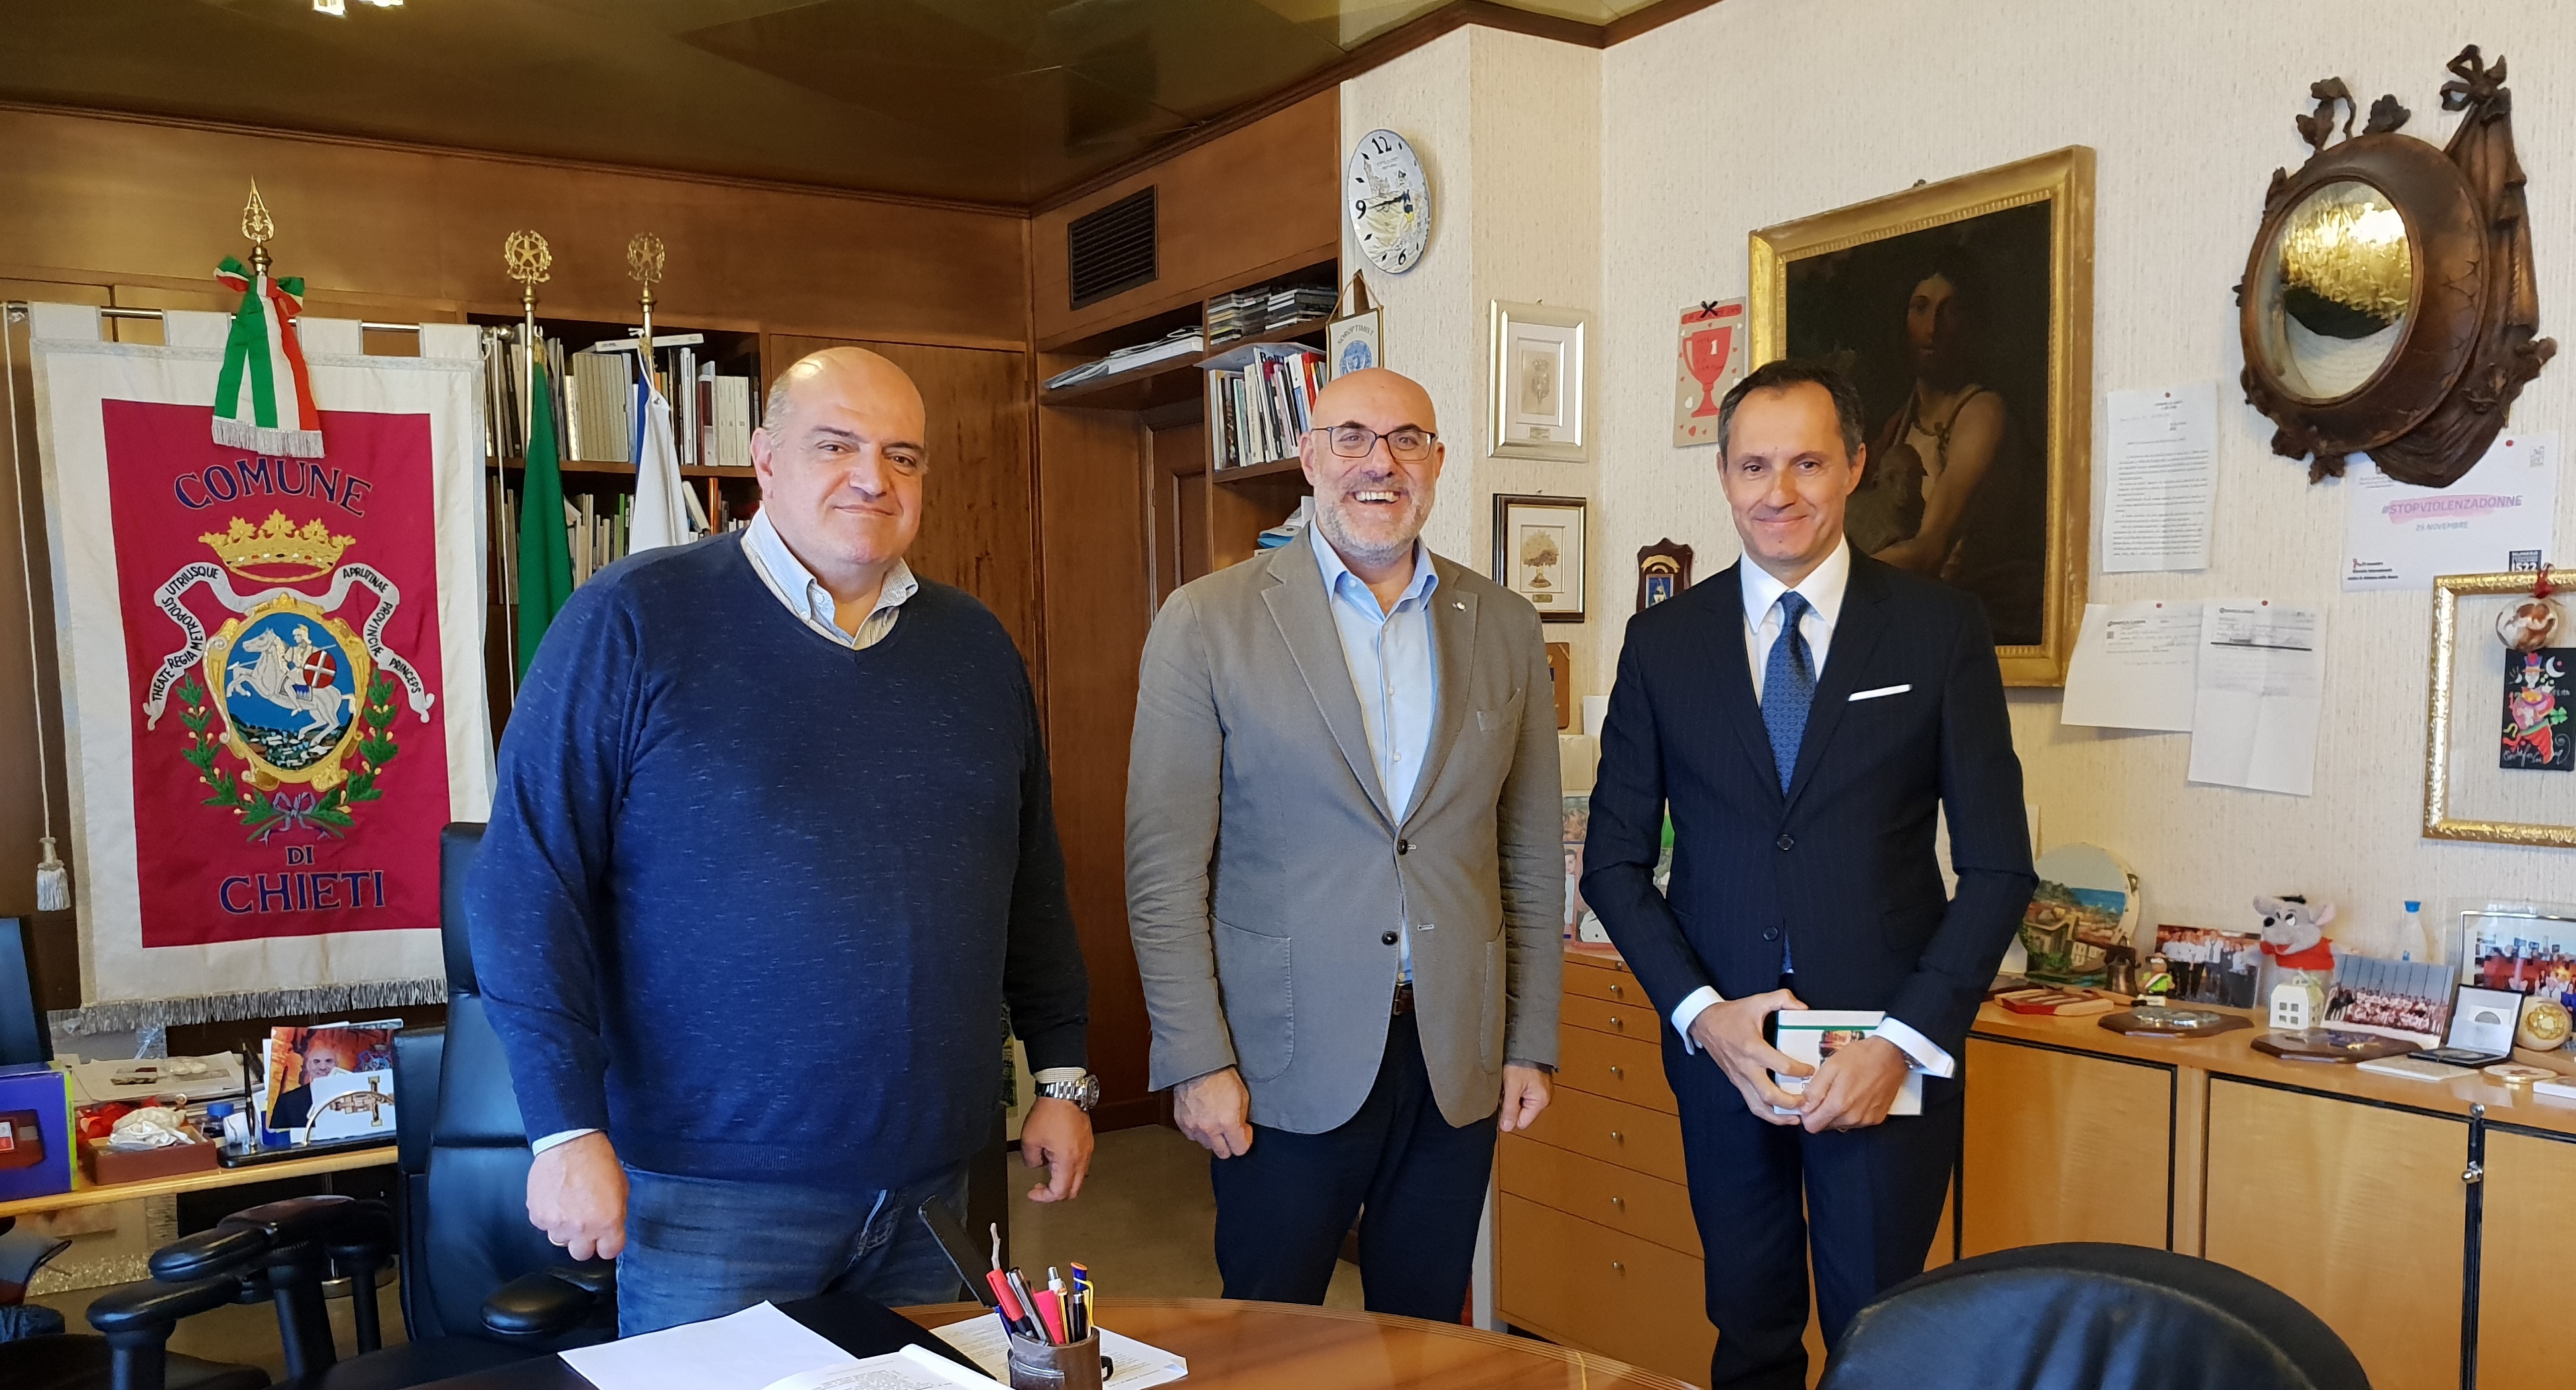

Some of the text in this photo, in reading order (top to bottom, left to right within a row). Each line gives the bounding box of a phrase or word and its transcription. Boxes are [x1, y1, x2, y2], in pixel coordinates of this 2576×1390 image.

[1371, 136, 1392, 154] 12
[1355, 200, 1367, 219] 9
[1398, 249, 1406, 265] 6
[1337, 324, 1375, 345] SOROPTIMIST
[174, 457, 373, 518] COMUNE
[2382, 495, 2523, 514] #STOPVIOLENZADONNE
[2426, 521, 2469, 531] NOVEMBRE
[165, 565, 219, 595] UTRIUSQUE
[162, 597, 203, 651] METROPOLIS
[167, 650, 198, 669] REGIA
[153, 667, 175, 701] THEATE
[389, 658, 421, 693] PRINCEPS
[285, 844, 314, 866] DI
[219, 870, 386, 915] CHIETI
